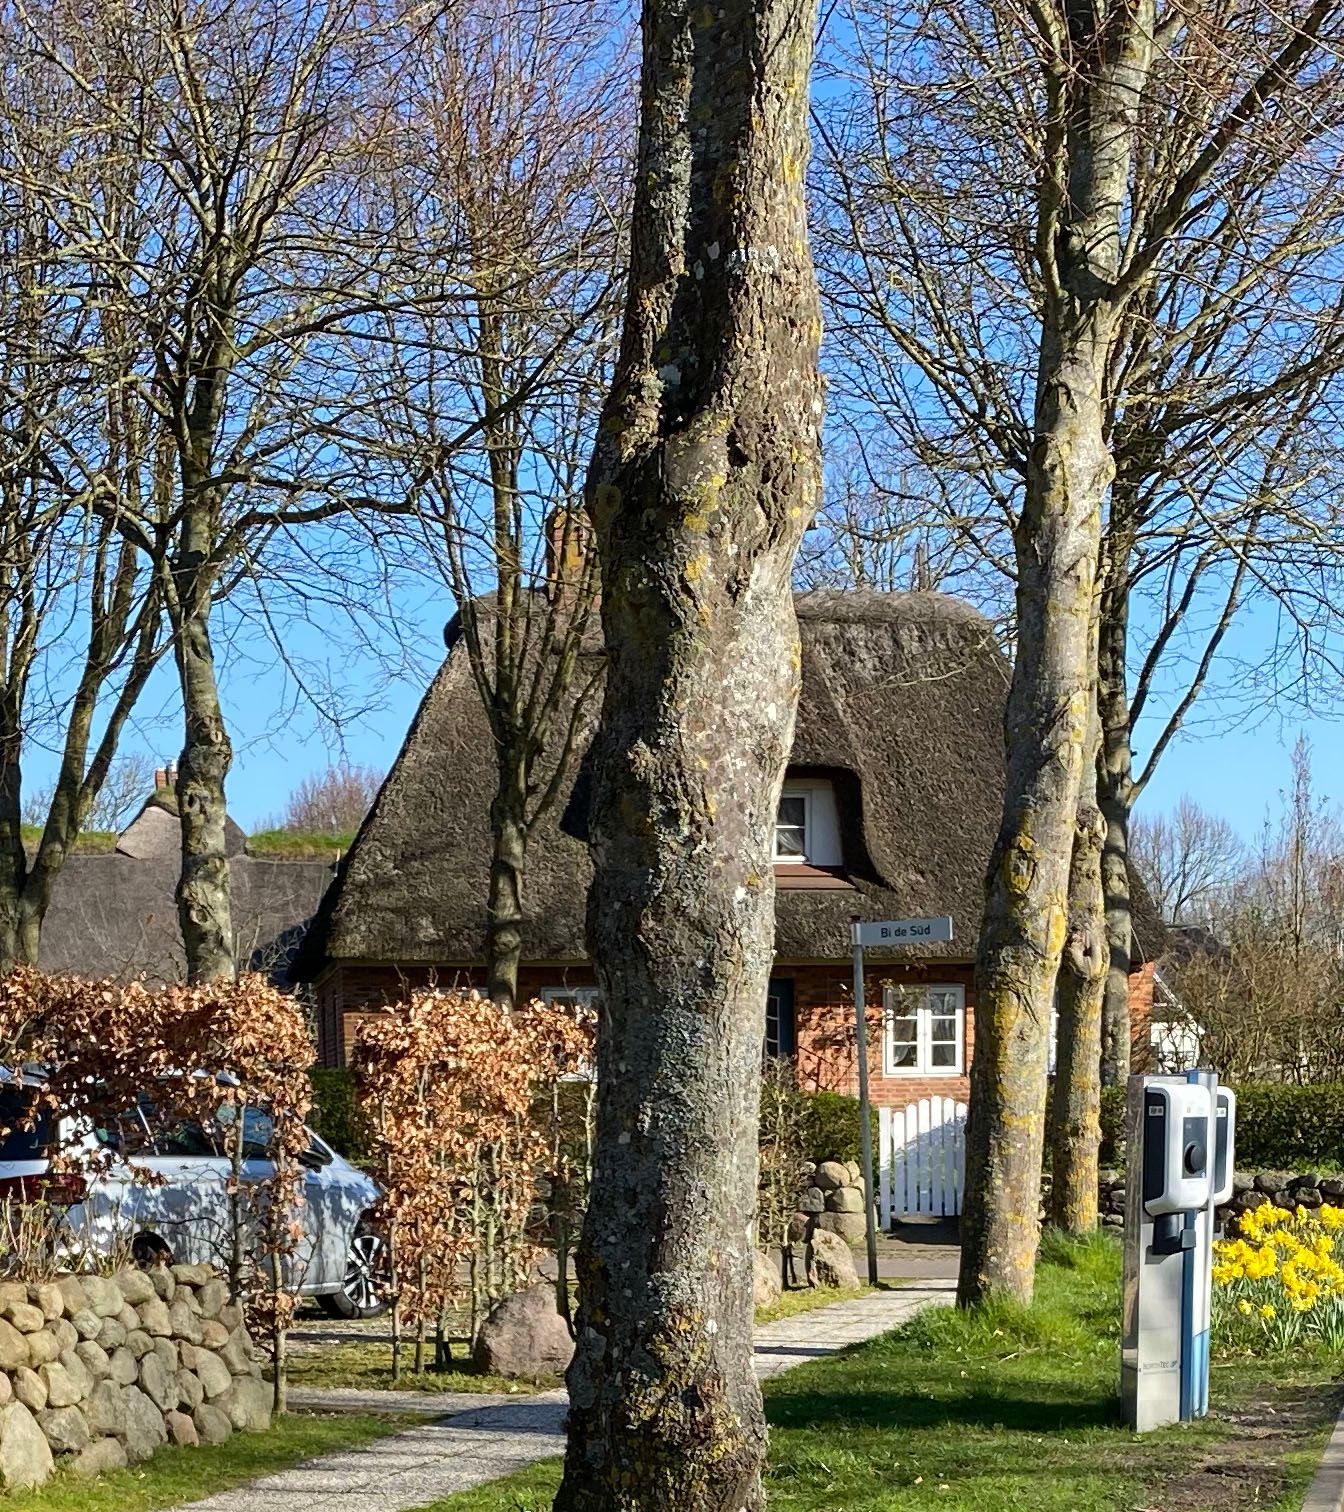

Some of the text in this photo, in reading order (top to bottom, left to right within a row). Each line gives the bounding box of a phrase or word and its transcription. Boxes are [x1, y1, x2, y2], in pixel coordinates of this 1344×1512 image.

[880, 924, 931, 938] Bi de Süd
